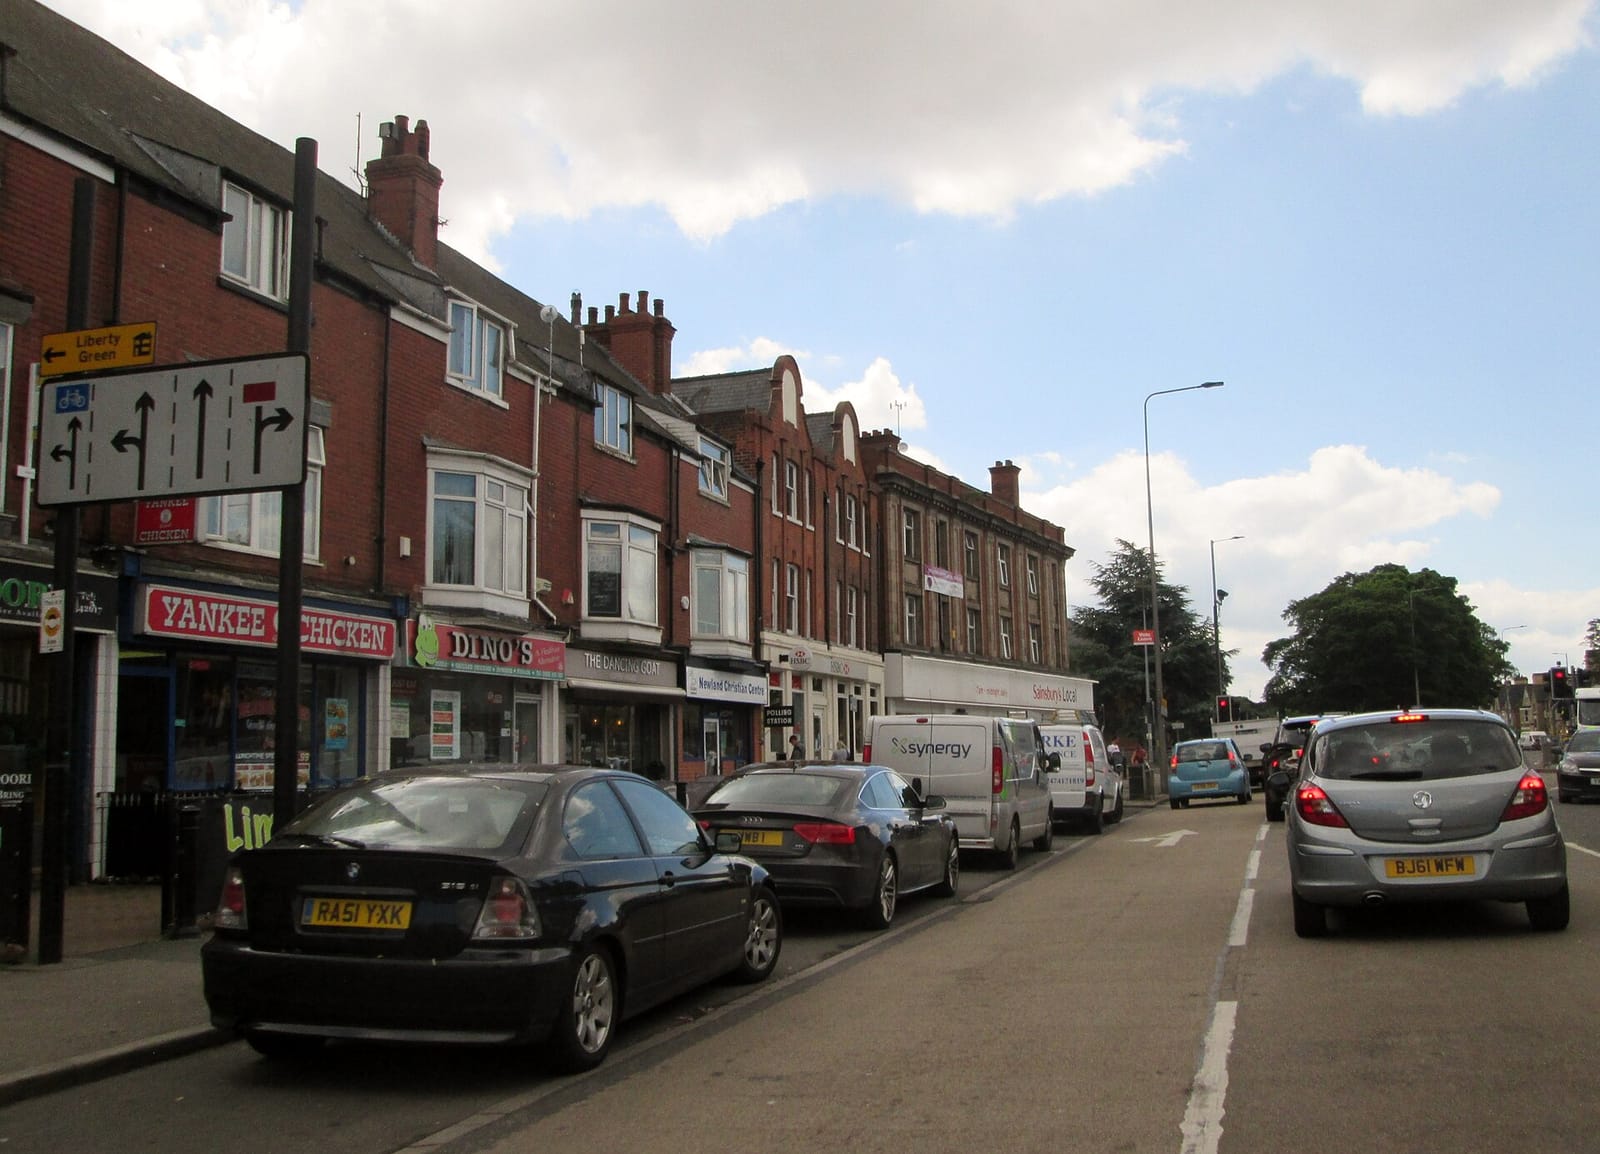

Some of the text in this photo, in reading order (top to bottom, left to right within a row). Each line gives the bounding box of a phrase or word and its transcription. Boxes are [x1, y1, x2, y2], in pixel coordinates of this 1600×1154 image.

[77, 334, 120, 348] Liberty
[80, 350, 116, 362] Green
[139, 529, 190, 542] CHICKEN
[162, 596, 265, 636] YANKEE
[452, 631, 533, 665] DINO'S
[584, 653, 660, 675] THE DANCING GOAT
[790, 657, 809, 665] HSBC
[699, 677, 764, 696] Newland Christian Centre
[1033, 684, 1077, 704] Sainsbury's Local
[766, 709, 792, 718] POLLING
[1043, 735, 1077, 748] RKE
[908, 743, 971, 759] synergy
[1395, 857, 1465, 875] BJ61 WFW
[317, 901, 405, 926] RA51 YXK
